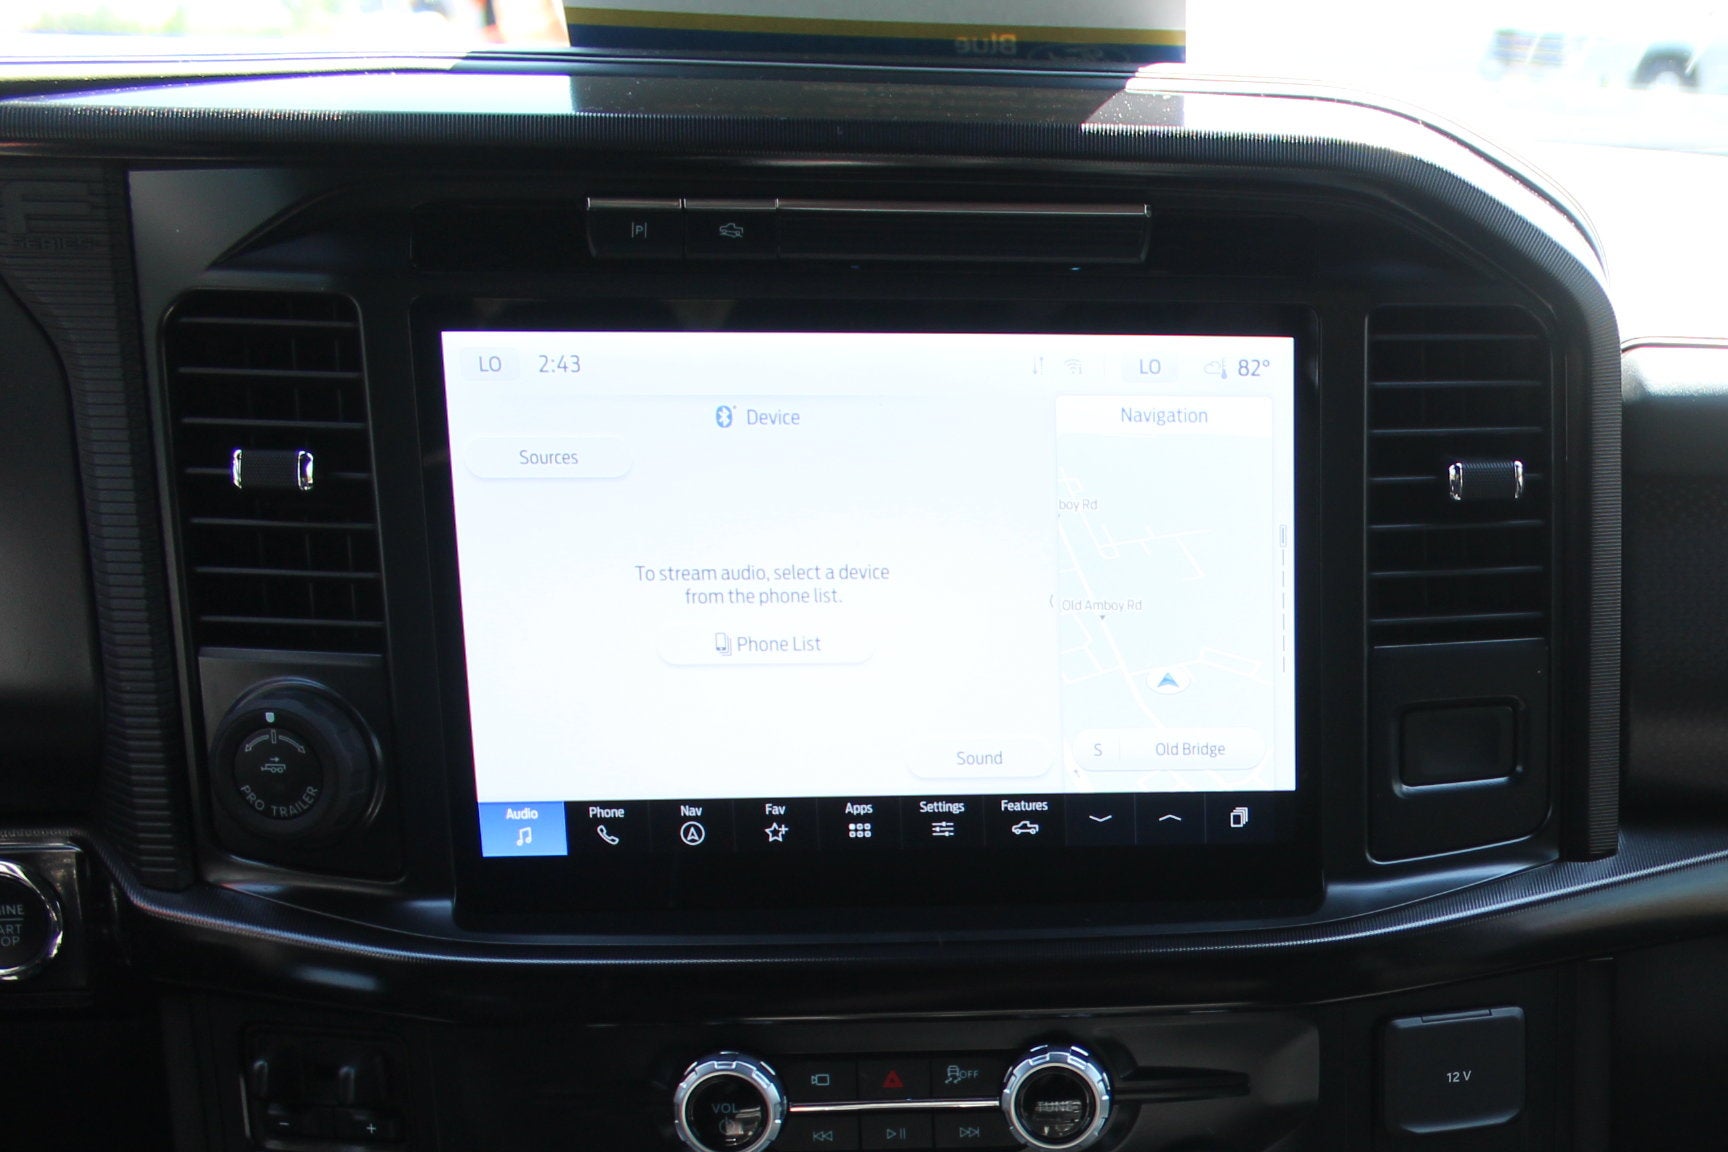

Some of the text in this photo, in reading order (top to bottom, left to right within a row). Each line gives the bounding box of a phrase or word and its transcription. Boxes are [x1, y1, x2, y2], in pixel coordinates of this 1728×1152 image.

[478, 355, 502, 372] LO
[539, 354, 582, 374] 2:43
[1140, 358, 1161, 376] LO
[746, 409, 800, 426] Device
[1121, 406, 1208, 426] Navigation
[519, 449, 579, 466] Sources
[635, 563, 890, 584] To stream audio, select a device
[685, 586, 843, 607] from the phone list.
[1062, 598, 1142, 614] Old Amboy Rd
[737, 635, 821, 652] Phone List
[1094, 742, 1103, 757] S
[1155, 741, 1226, 759] Old Bridge
[956, 750, 1003, 766] Sound
[240, 784, 319, 817] PRO TRAILER
[919, 799, 965, 814] Settings
[1001, 799, 1048, 812] Features
[505, 807, 538, 821] Audio
[589, 804, 625, 819] Phone
[680, 804, 703, 817] Nav
[765, 803, 786, 816] Fav
[845, 802, 873, 817] Apps
[960, 1068, 979, 1080] OFF
[1446, 1070, 1472, 1083] 12 V
[712, 1103, 738, 1115] VOL
